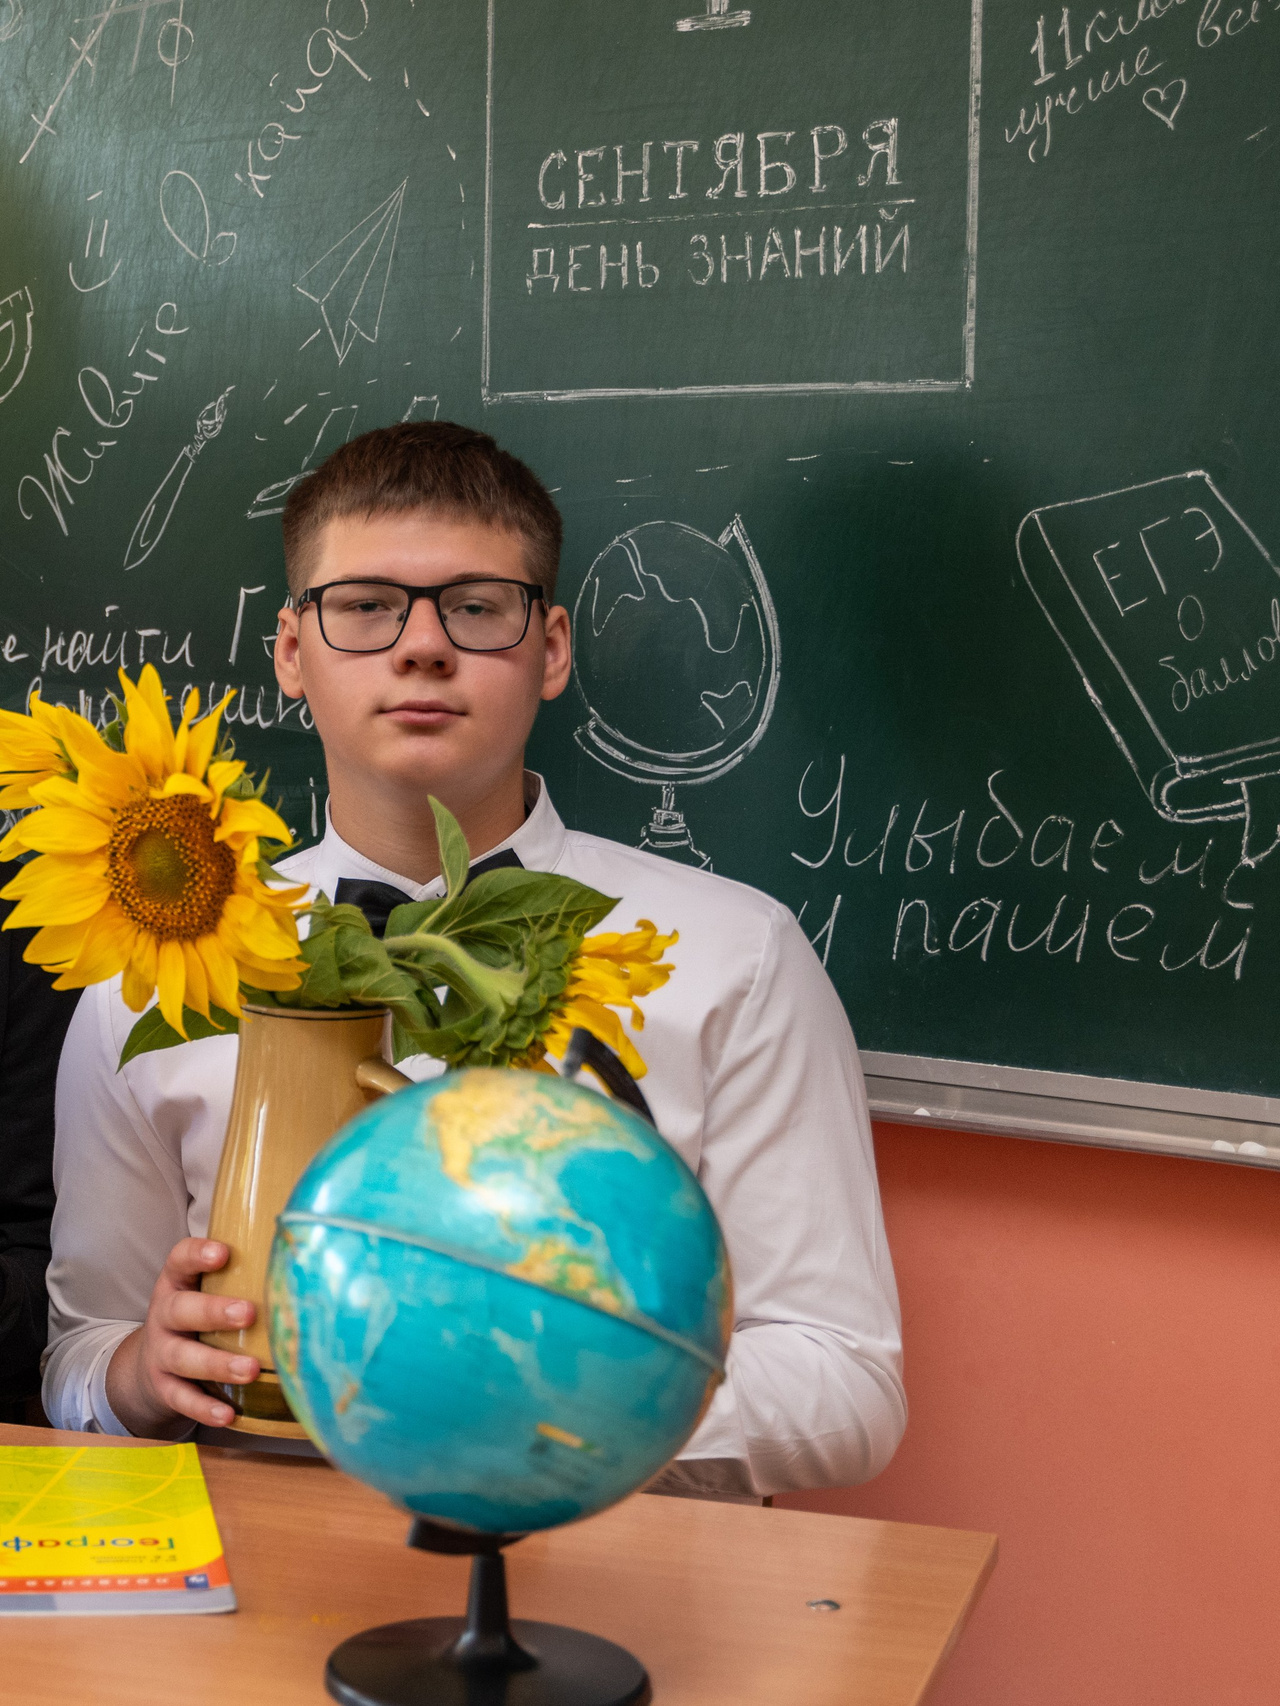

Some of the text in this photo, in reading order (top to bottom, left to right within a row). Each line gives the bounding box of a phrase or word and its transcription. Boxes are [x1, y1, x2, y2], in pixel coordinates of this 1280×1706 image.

[538, 117, 903, 210] СЕНТЯБРЯ
[526, 207, 910, 295] ДЕНЬ ЗНАНИЙ
[1093, 508, 1222, 617] ЕГЭ
[40, 604, 194, 673] найти
[892, 894, 1252, 980] пашем
